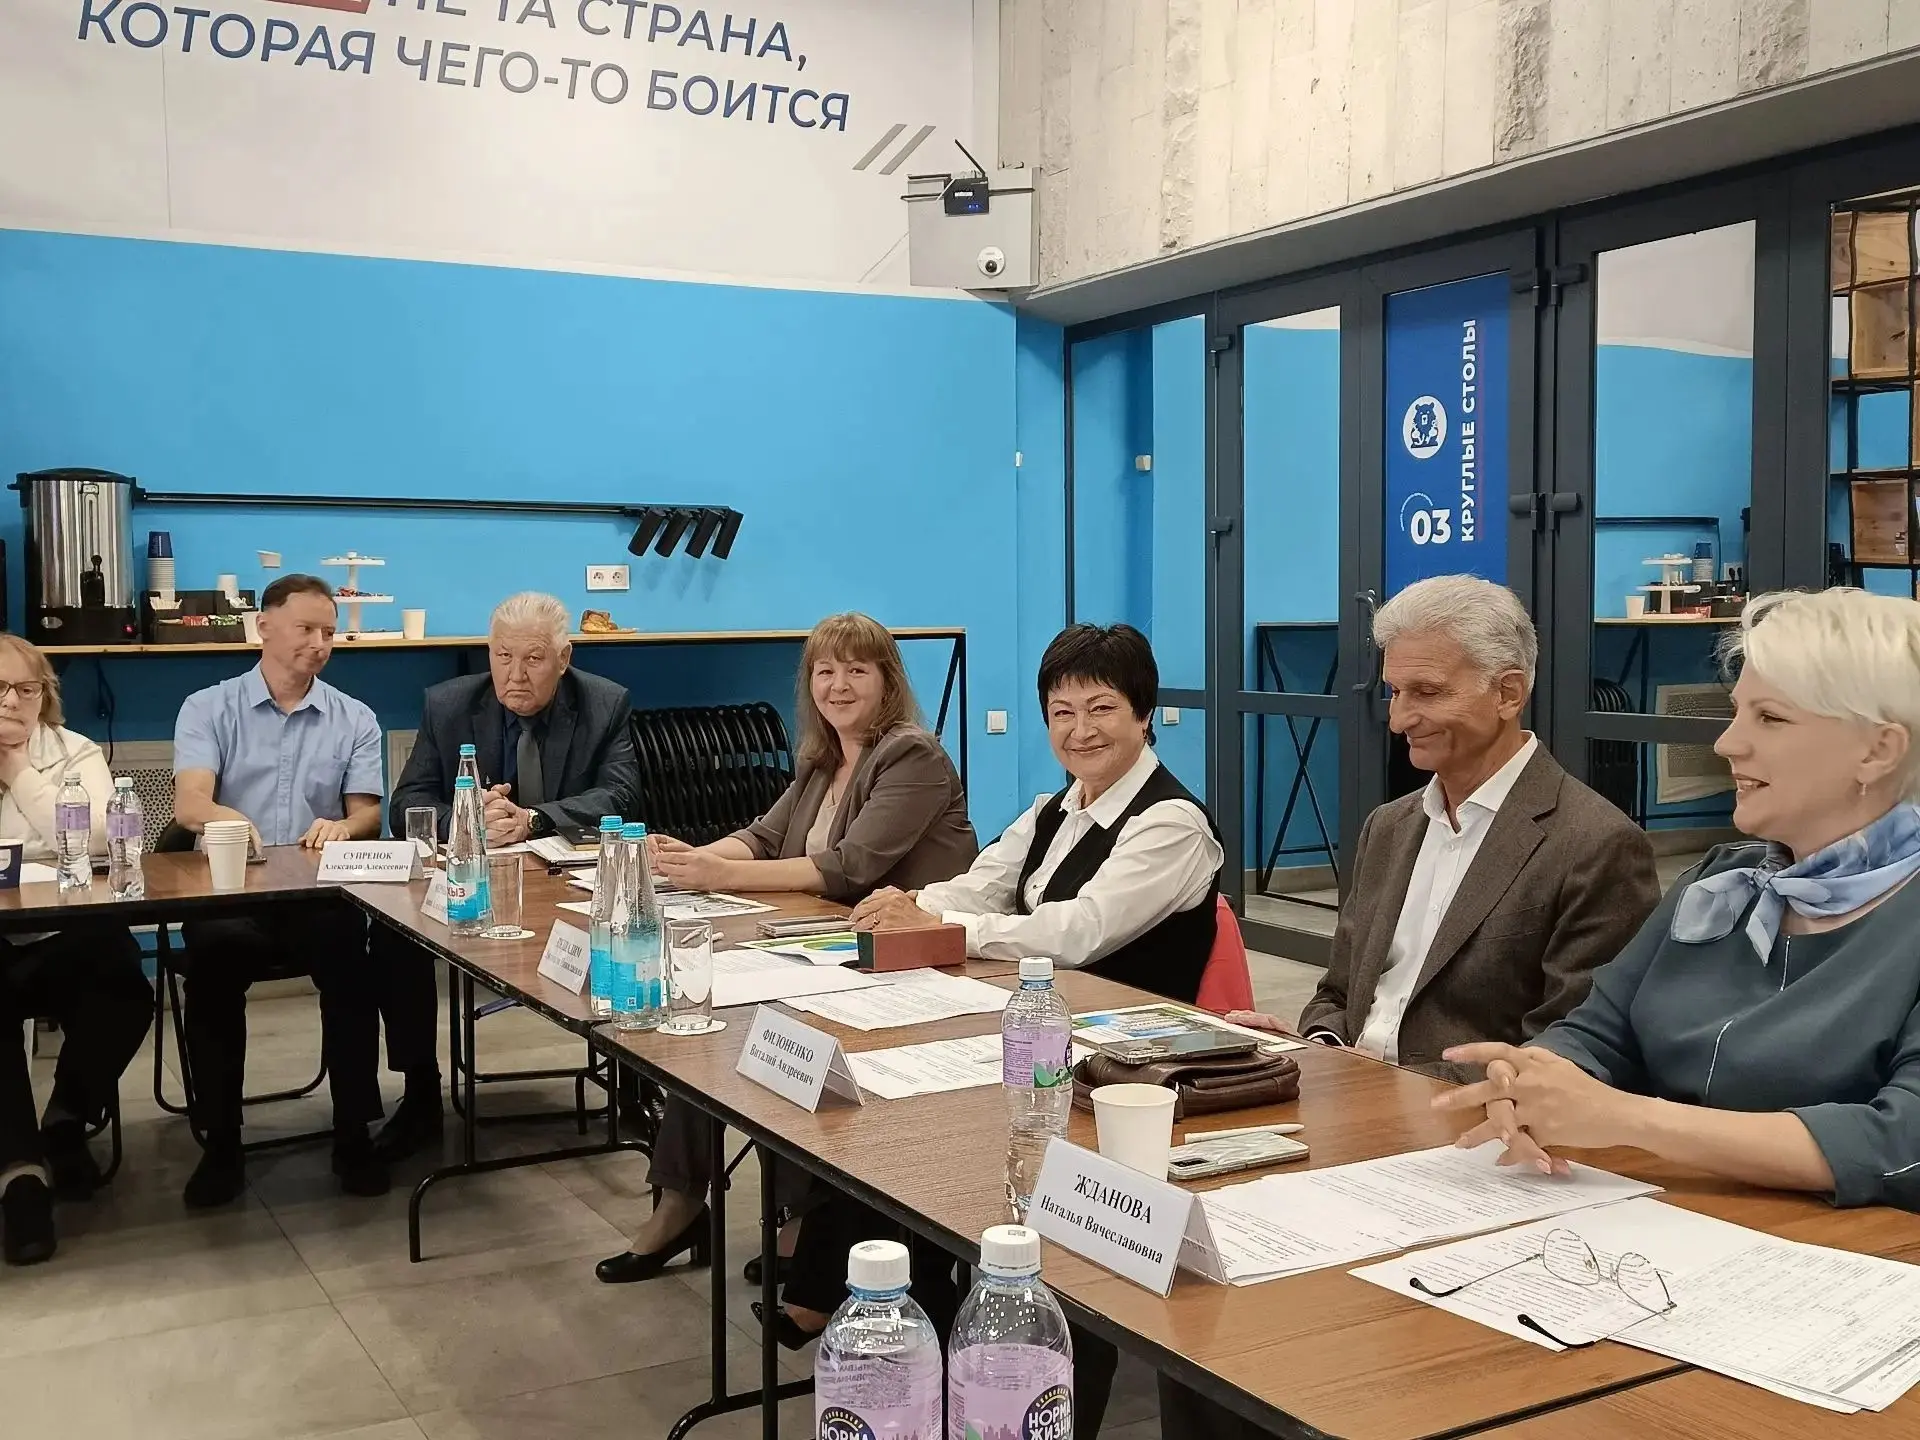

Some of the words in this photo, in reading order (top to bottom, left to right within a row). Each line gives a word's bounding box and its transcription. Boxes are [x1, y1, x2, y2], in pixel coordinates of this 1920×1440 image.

[577, 0, 807, 71] СТРАНА,
[78, 0, 376, 74] КОТОРАЯ
[396, 36, 629, 104] ЧЕГО-ТО
[647, 70, 850, 131] БОИТСЯ
[1462, 319, 1476, 413] СТОЛЫ
[1461, 421, 1475, 542] КРУГЛЫЕ
[1410, 508, 1451, 545] 03
[749, 1043, 777, 1068] Виталий
[777, 1058, 814, 1086] Андреевич
[762, 1029, 814, 1063] ФИЛОНЕНКО
[1074, 1173, 1152, 1225] ЖДАНОВА
[1040, 1194, 1083, 1227] Наталья
[1084, 1215, 1164, 1265] Вячеславовна
[1028, 1398, 1071, 1429] НОРМА
[1029, 1414, 1072, 1440] ЖИЗНИ
